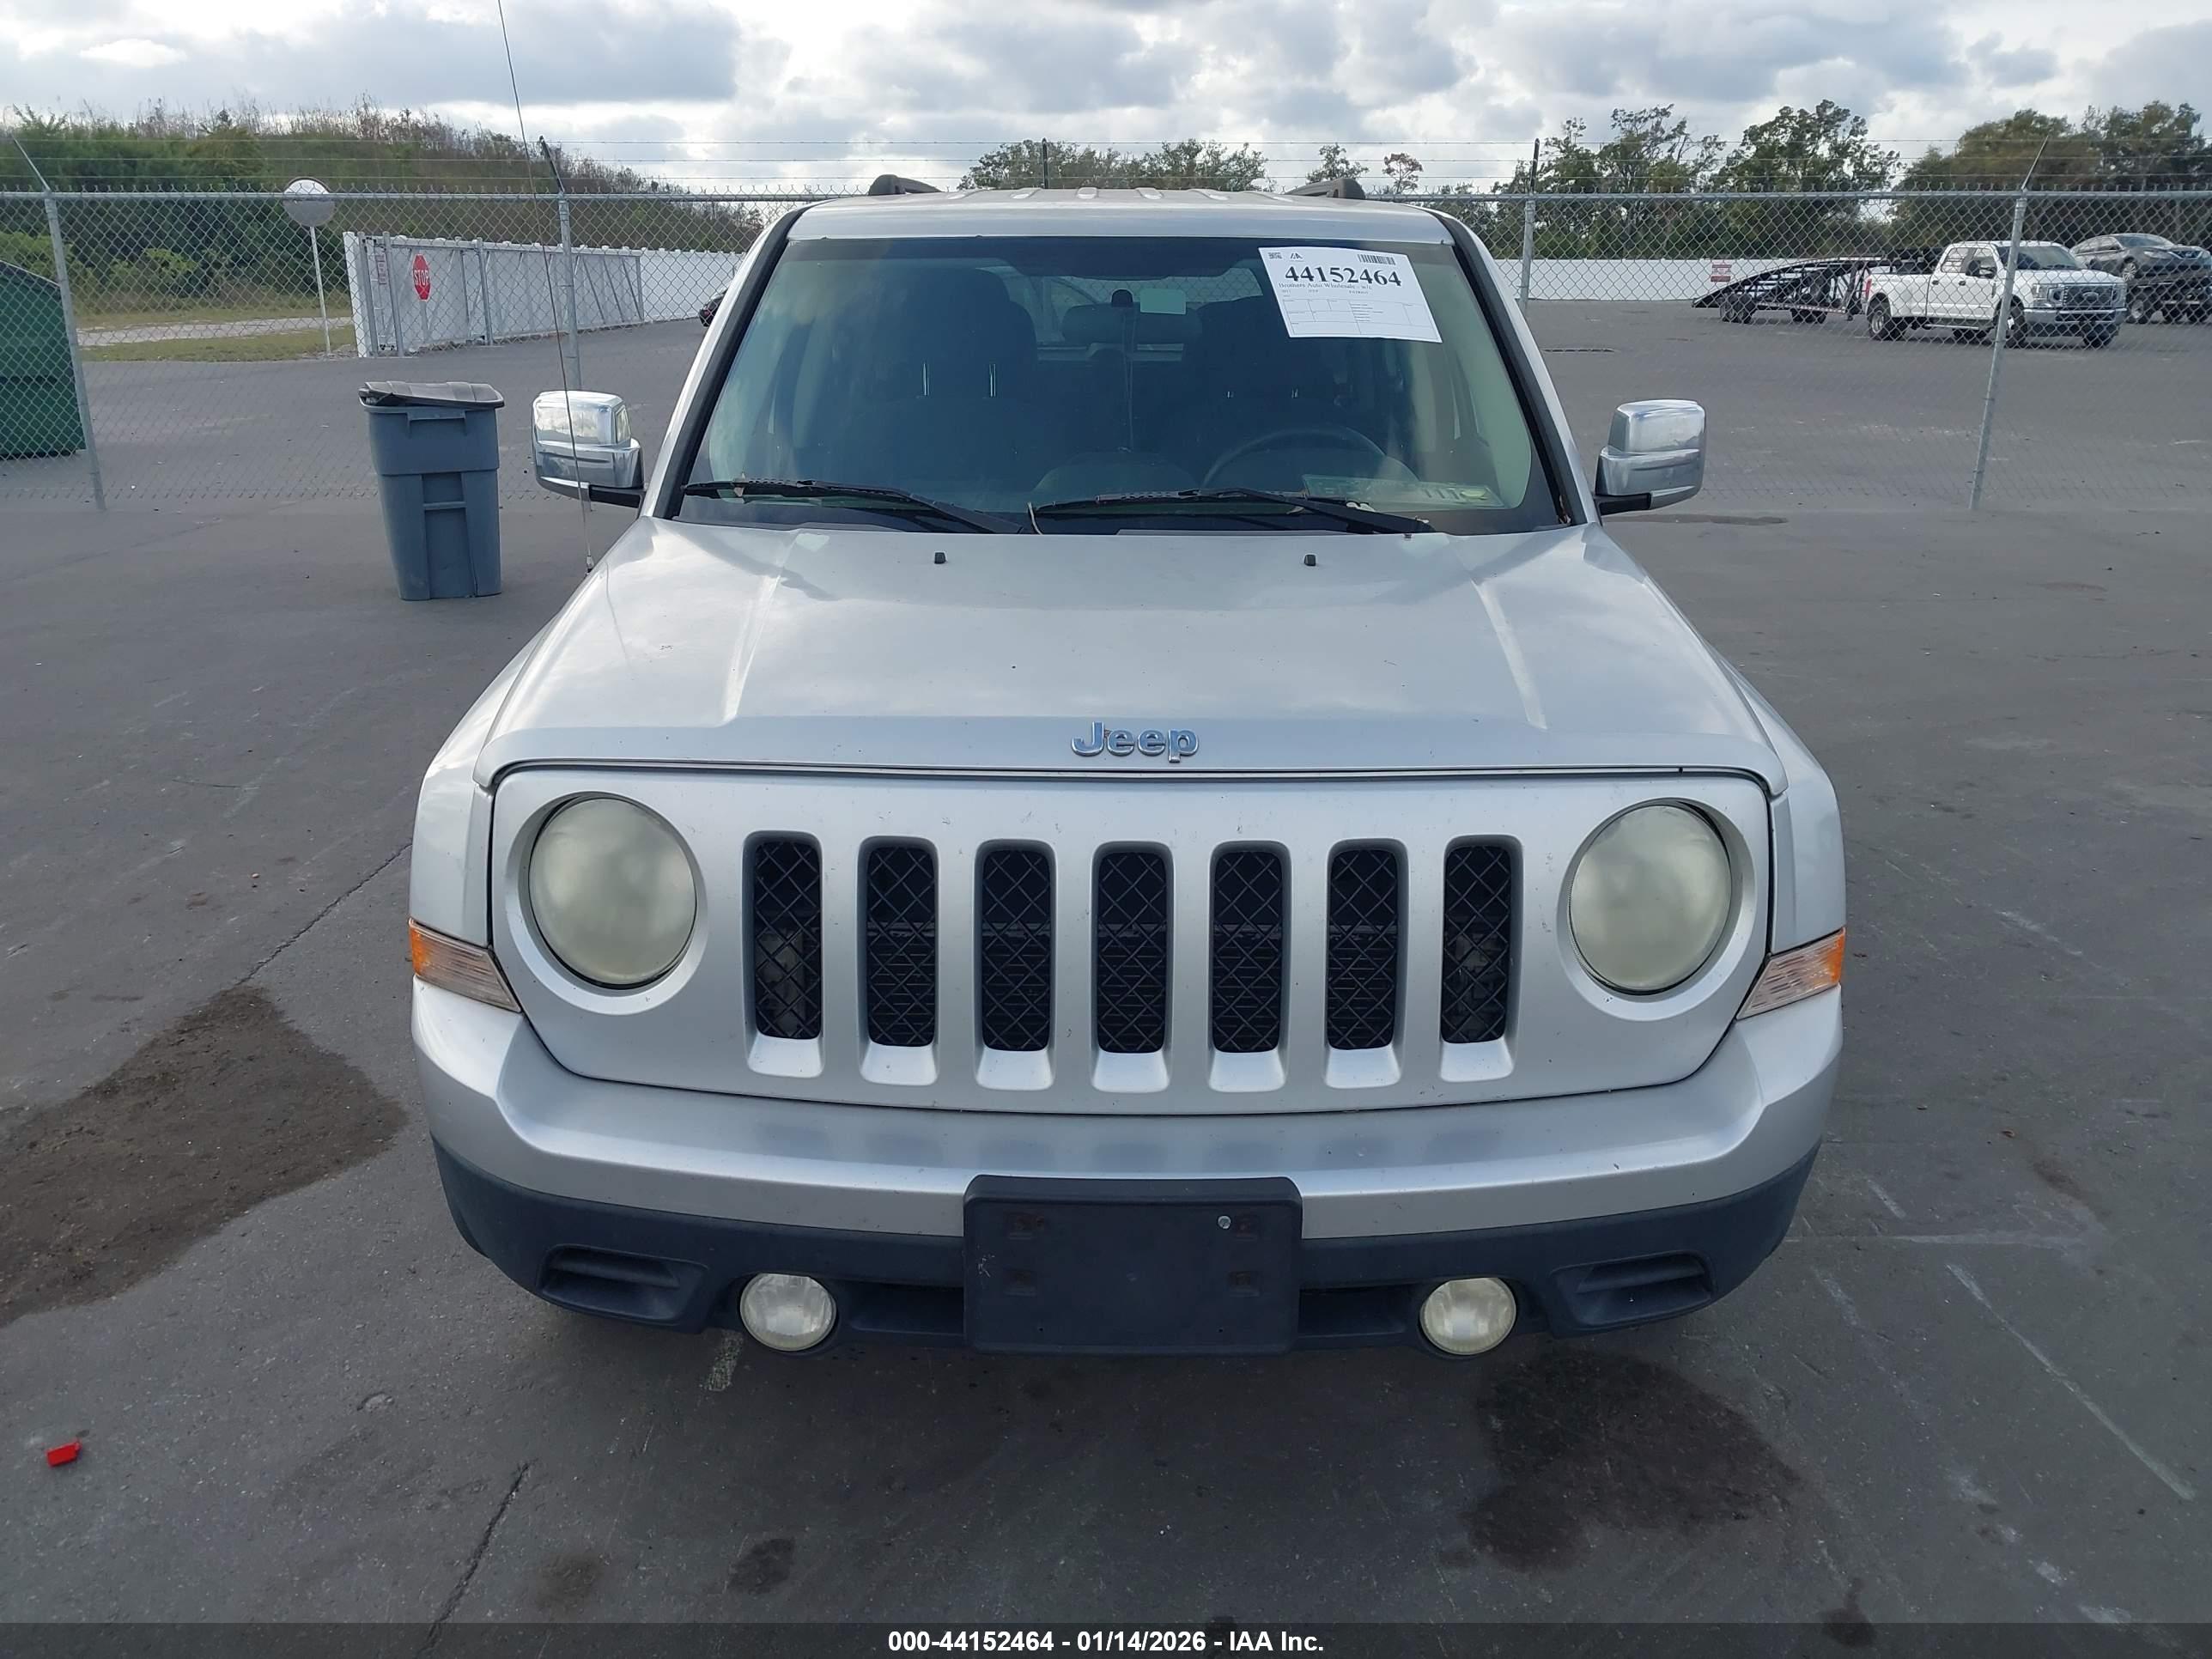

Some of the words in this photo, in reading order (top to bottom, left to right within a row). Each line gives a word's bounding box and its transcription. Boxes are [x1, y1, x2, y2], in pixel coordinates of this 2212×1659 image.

[414, 269, 429, 285] STOP
[1285, 265, 1401, 287] 44152464
[1071, 720, 1199, 763] Jeep
